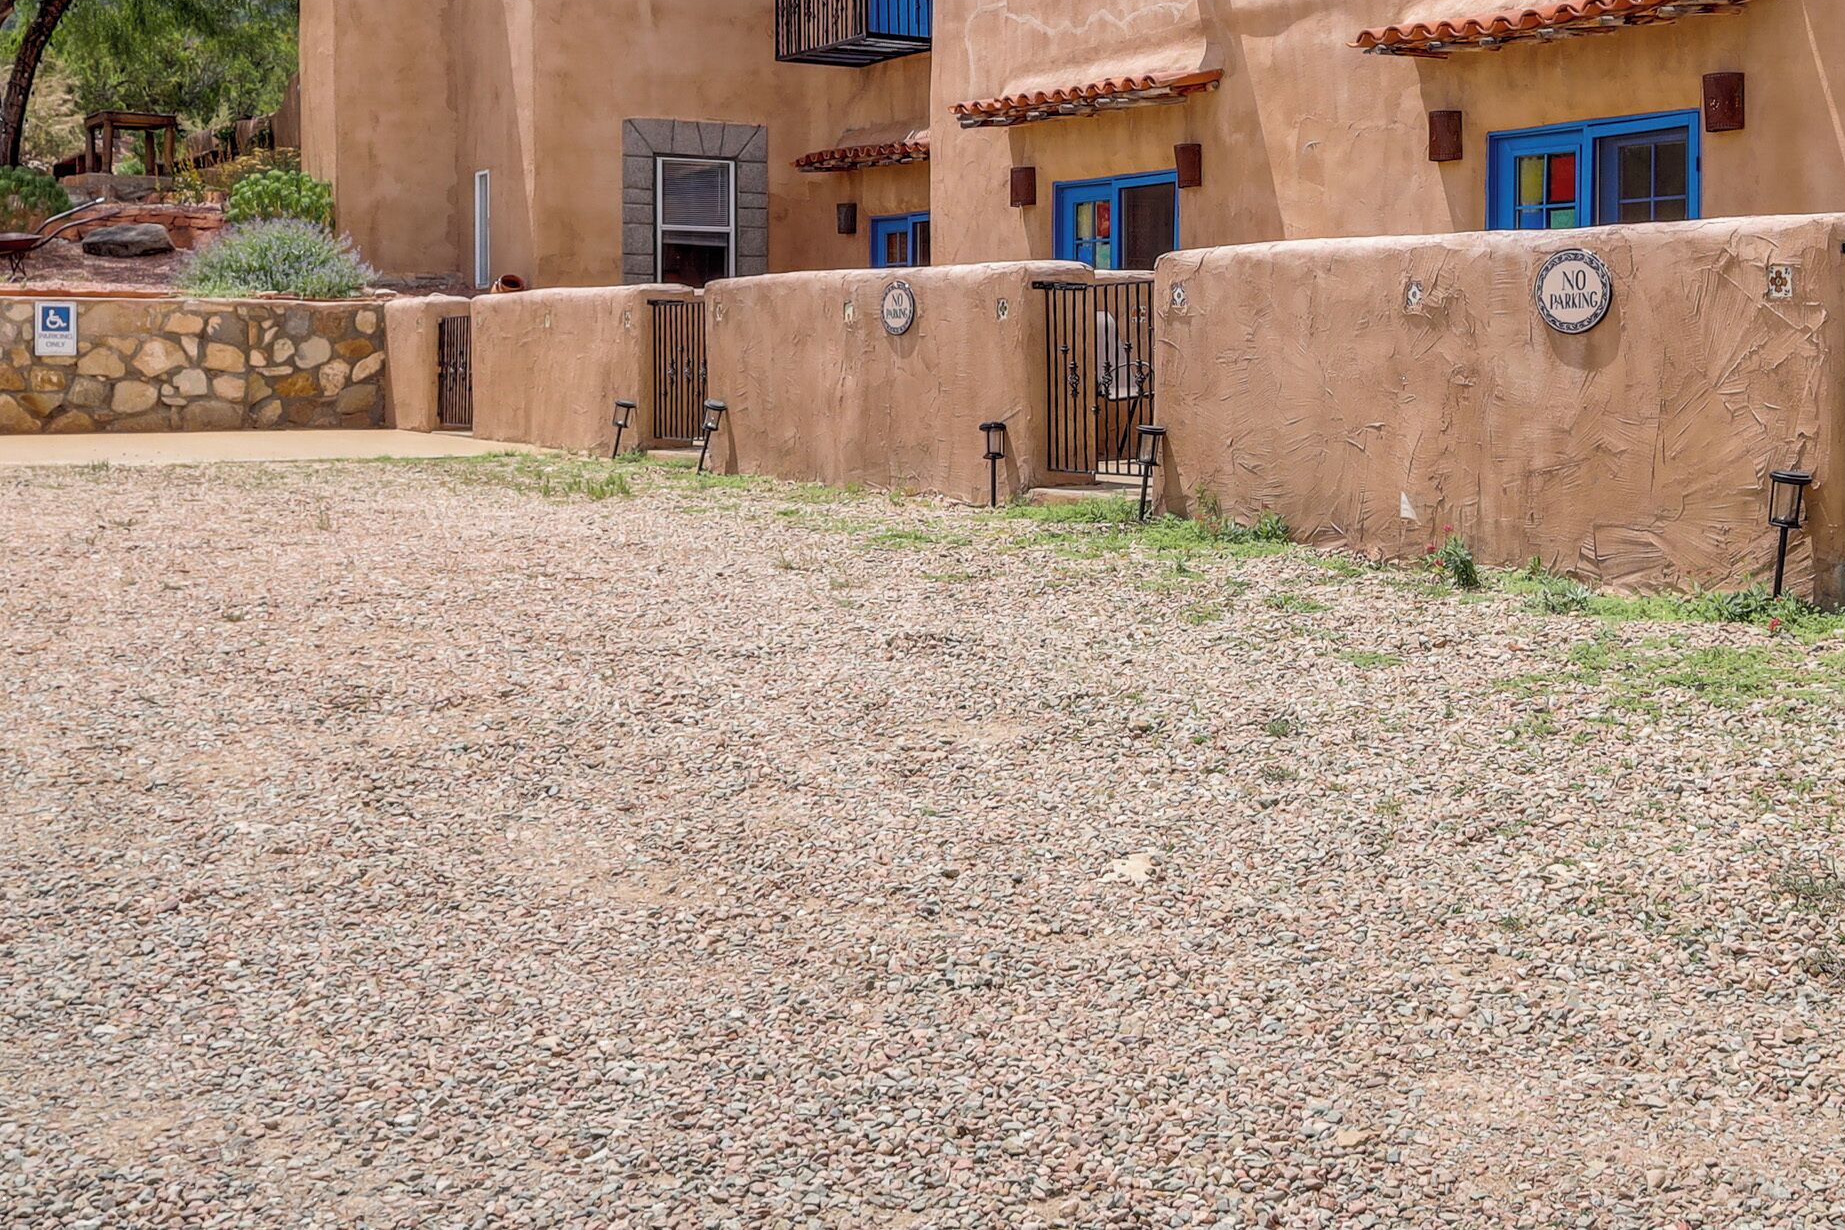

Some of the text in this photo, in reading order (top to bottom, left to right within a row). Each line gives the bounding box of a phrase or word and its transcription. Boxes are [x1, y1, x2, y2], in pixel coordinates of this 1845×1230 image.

[1562, 269, 1586, 291] NO
[891, 293, 904, 307] NO
[1550, 291, 1598, 310] PARKING
[38, 332, 73, 340] PARKING
